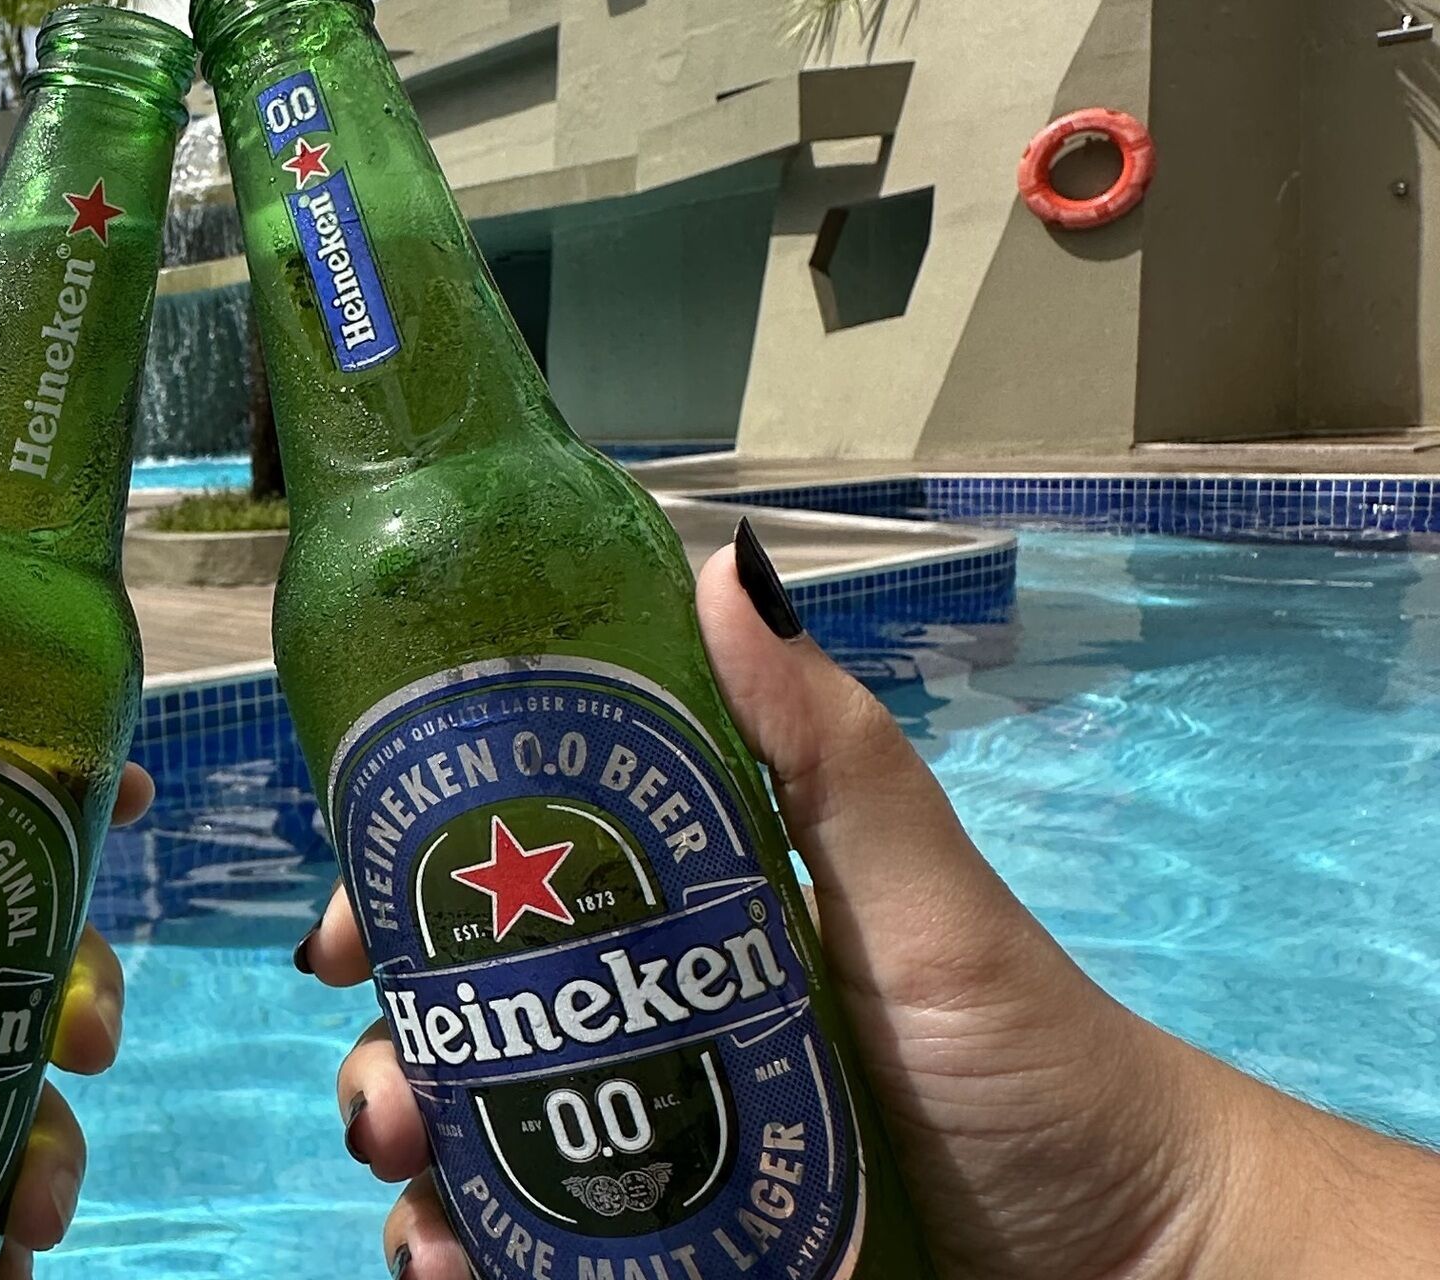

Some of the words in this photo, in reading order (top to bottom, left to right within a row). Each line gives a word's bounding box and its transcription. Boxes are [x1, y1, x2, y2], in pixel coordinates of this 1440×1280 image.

[266, 86, 318, 134] 0.0
[352, 738, 407, 797] PREMIUM
[411, 703, 490, 742] QUALITY
[501, 696, 565, 716] LAGER
[576, 698, 624, 723] BEER
[7, 805, 37, 836] BEER
[364, 738, 499, 931] HEINEKEN
[512, 730, 588, 778] 0.0
[599, 743, 708, 864] BEER
[452, 925, 486, 943] EST.
[576, 890, 617, 914] 1873
[755, 1057, 791, 1083] MARK
[544, 1080, 653, 1161] 0.0
[712, 1121, 806, 1272] LAGER
